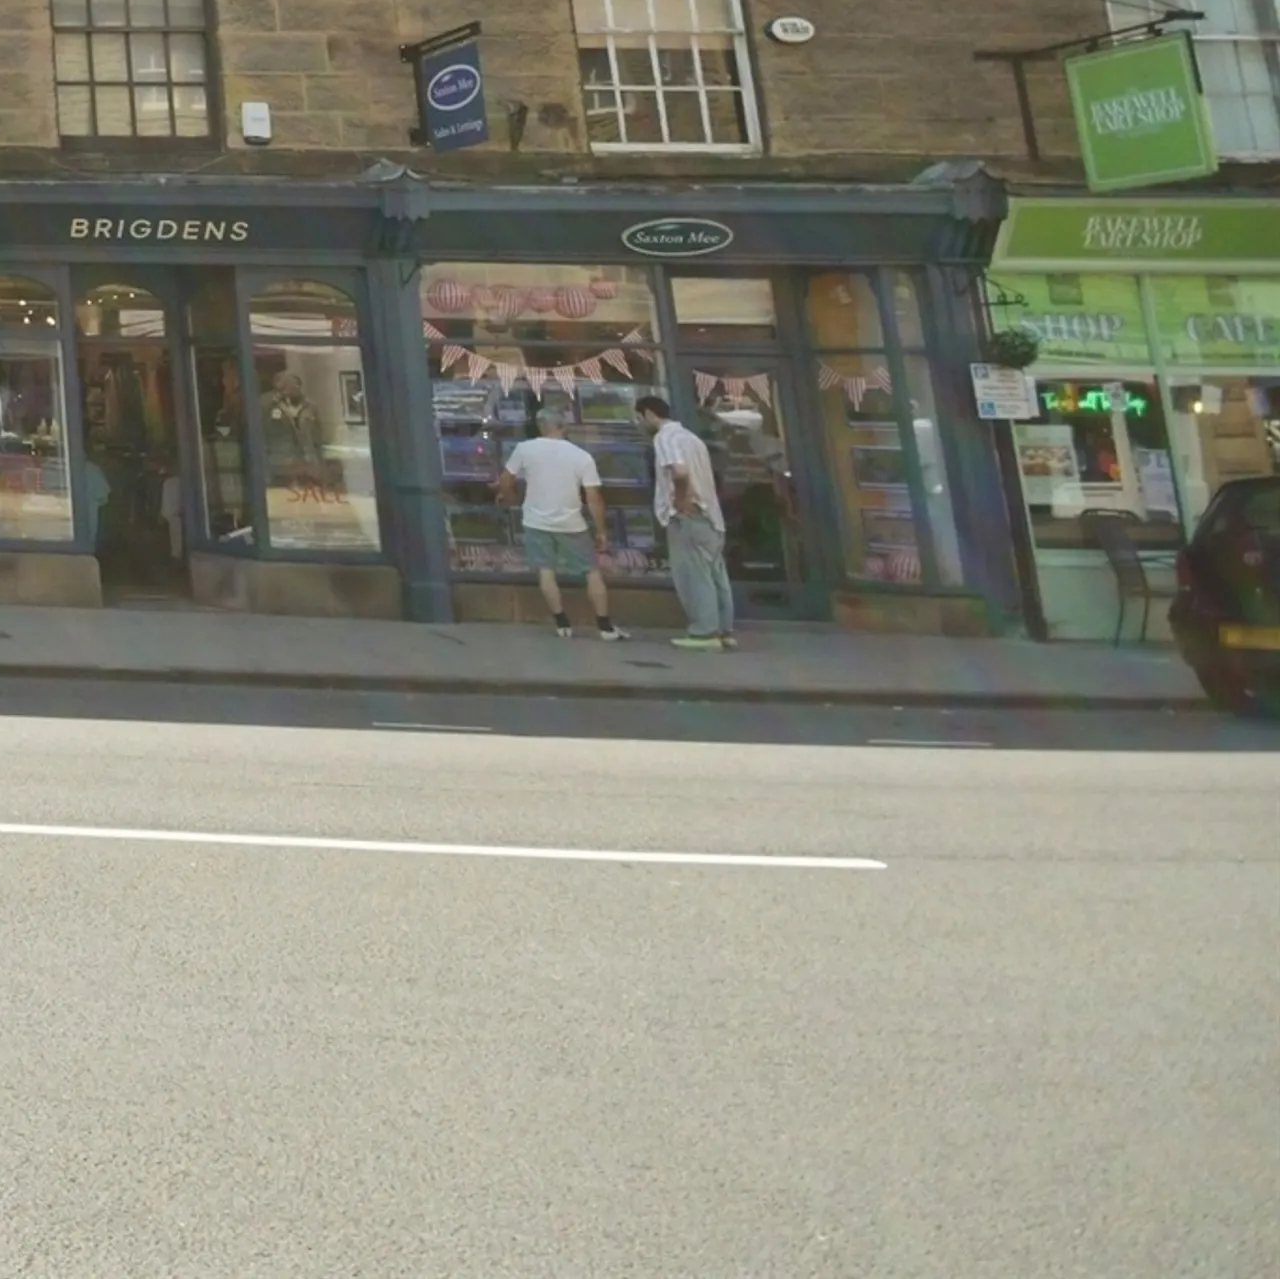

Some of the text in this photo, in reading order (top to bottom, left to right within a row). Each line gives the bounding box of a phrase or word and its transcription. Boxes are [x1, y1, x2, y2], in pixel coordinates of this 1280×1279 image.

[1091, 86, 1178, 122] BAKEWELL
[1136, 96, 1186, 124] SHOP
[70, 218, 249, 241] BRIGDENS
[1082, 216, 1199, 235] BAKEWELL
[634, 231, 721, 244] Saxton Mee
[1082, 229, 1202, 249] TART SHOP
[286, 479, 350, 505] SALE
